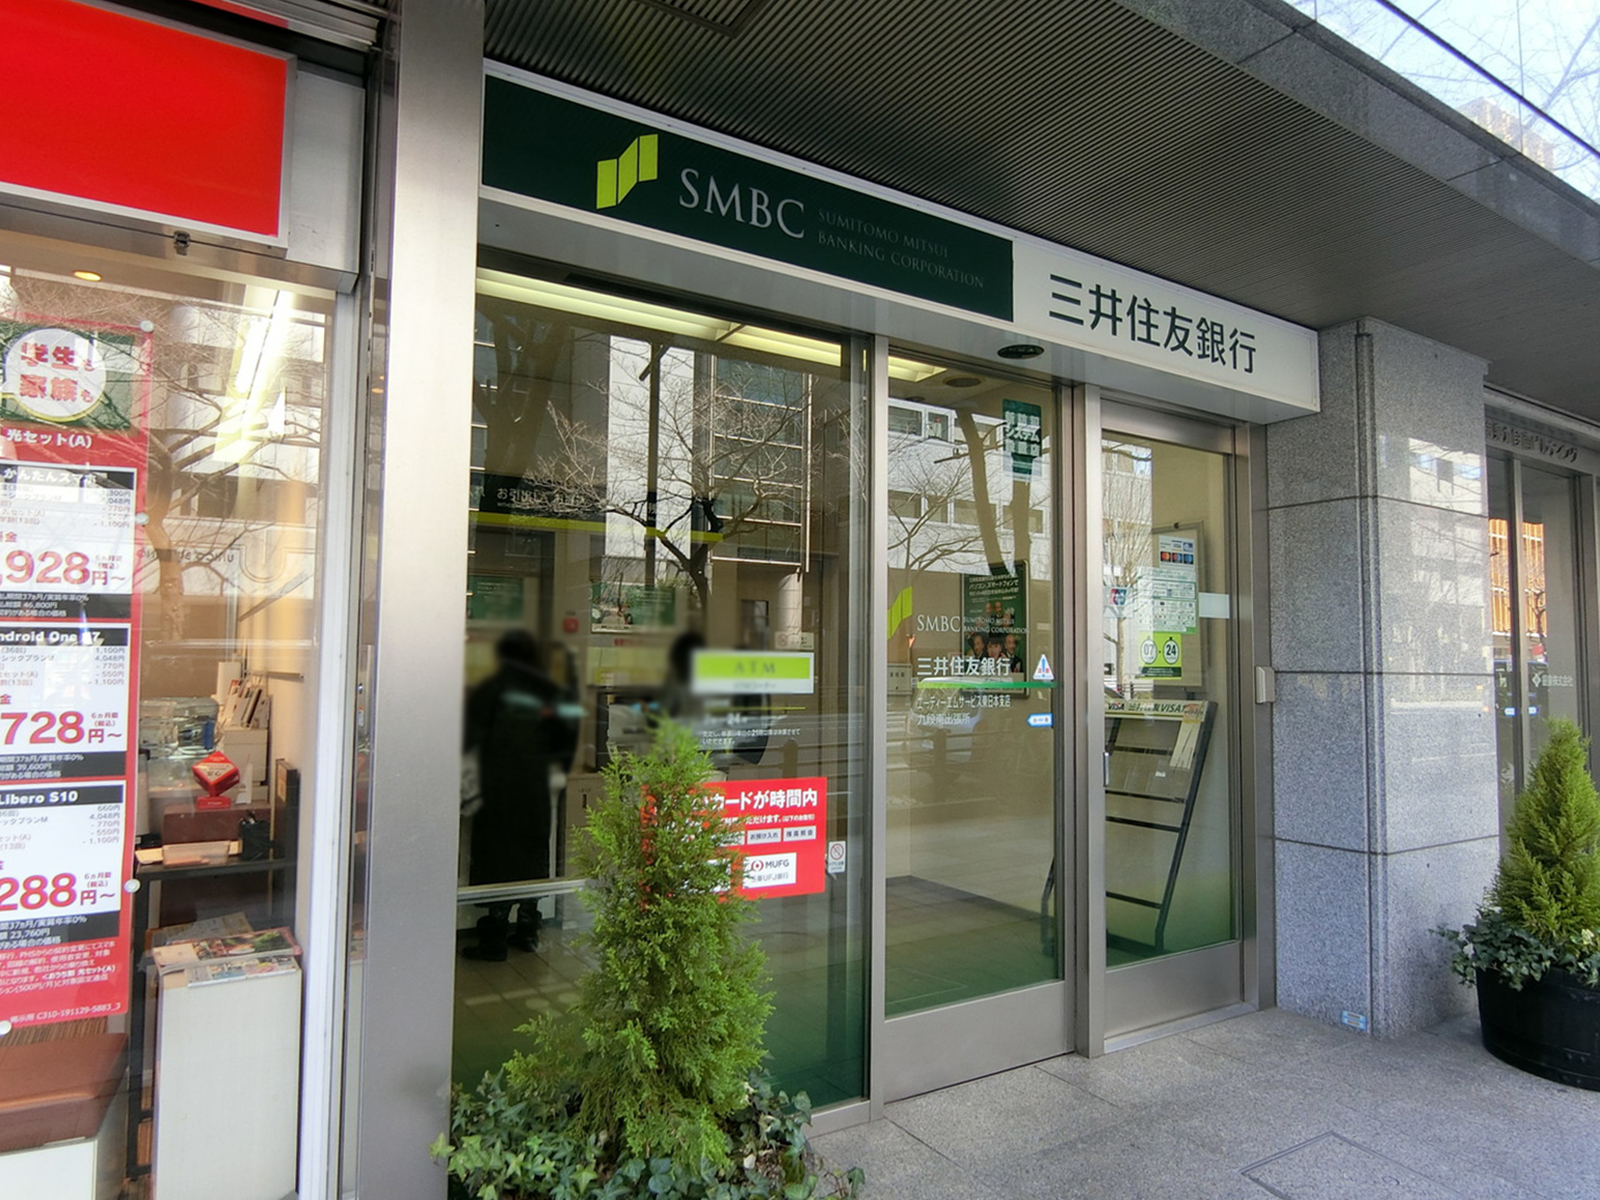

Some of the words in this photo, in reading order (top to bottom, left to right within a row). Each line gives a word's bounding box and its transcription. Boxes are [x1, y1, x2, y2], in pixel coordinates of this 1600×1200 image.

[678, 168, 805, 239] SMBC
[818, 207, 899, 243] SUMITOMO
[904, 236, 949, 258] MITSUI
[818, 230, 886, 262] BANKING
[891, 250, 984, 288] CORPORATION
[1048, 273, 1257, 374] 三井住友銀行
[6, 429, 93, 449] 光セット(A)
[916, 614, 961, 633] SMBC
[49, 631, 77, 643] One
[1143, 643, 1154, 656] 07
[1166, 643, 1177, 656] 24
[916, 656, 1012, 677] 三井住友銀行
[0, 711, 85, 745] 728
[0, 794, 45, 805] Libero
[49, 790, 78, 802] S10
[765, 859, 790, 868] MUFG
[0, 872, 77, 911] 288
